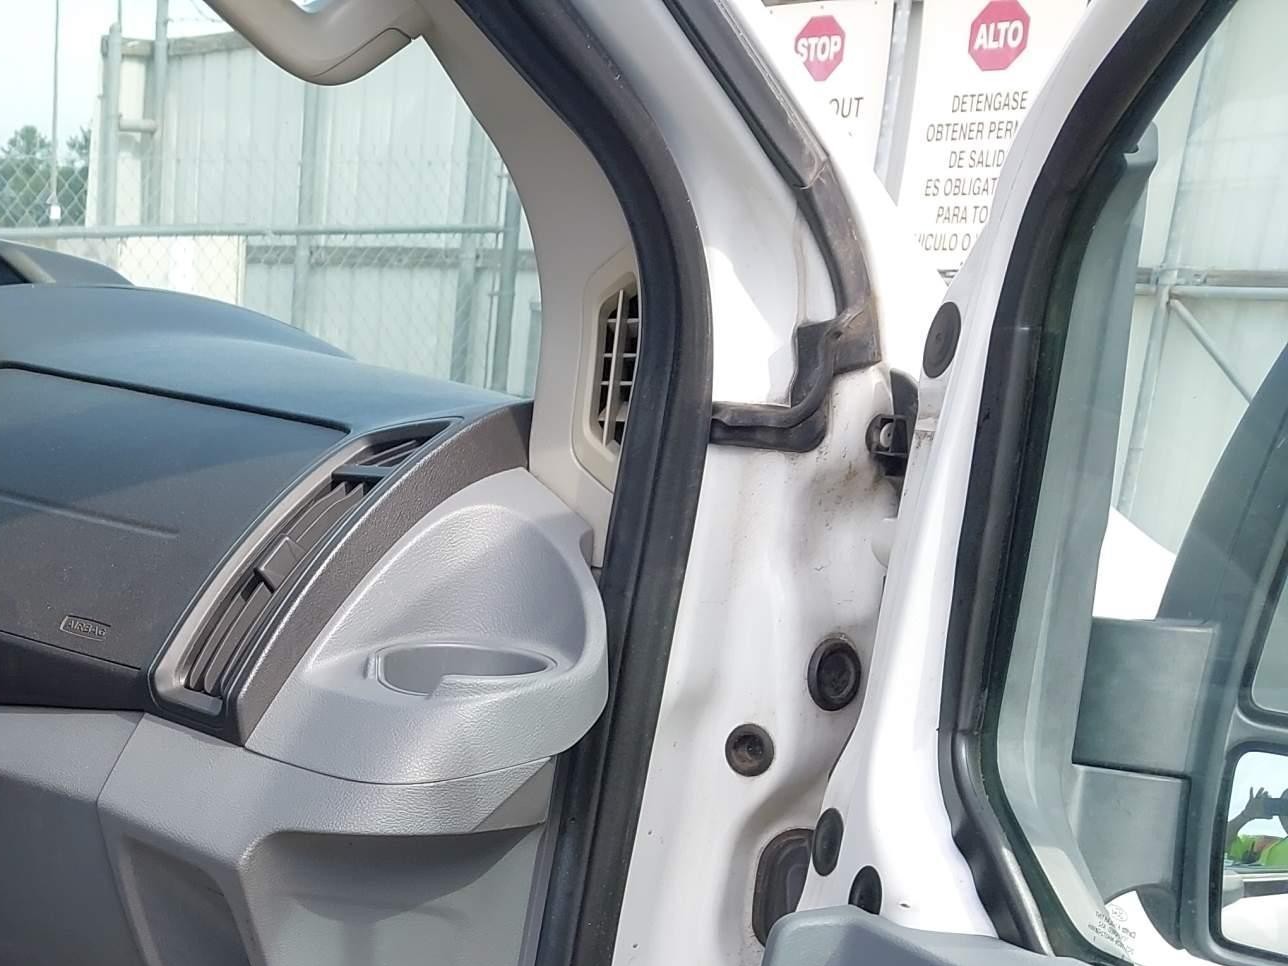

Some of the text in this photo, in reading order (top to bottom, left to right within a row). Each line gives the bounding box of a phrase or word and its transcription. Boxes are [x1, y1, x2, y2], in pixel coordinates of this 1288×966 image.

[974, 20, 1024, 50] ALTO
[797, 35, 842, 62] STOP
[951, 91, 1028, 113] DETENGASE
[926, 122, 984, 142] OBTENER
[948, 151, 965, 168] DE
[924, 178, 940, 197] ES
[936, 206, 967, 224] PARA
